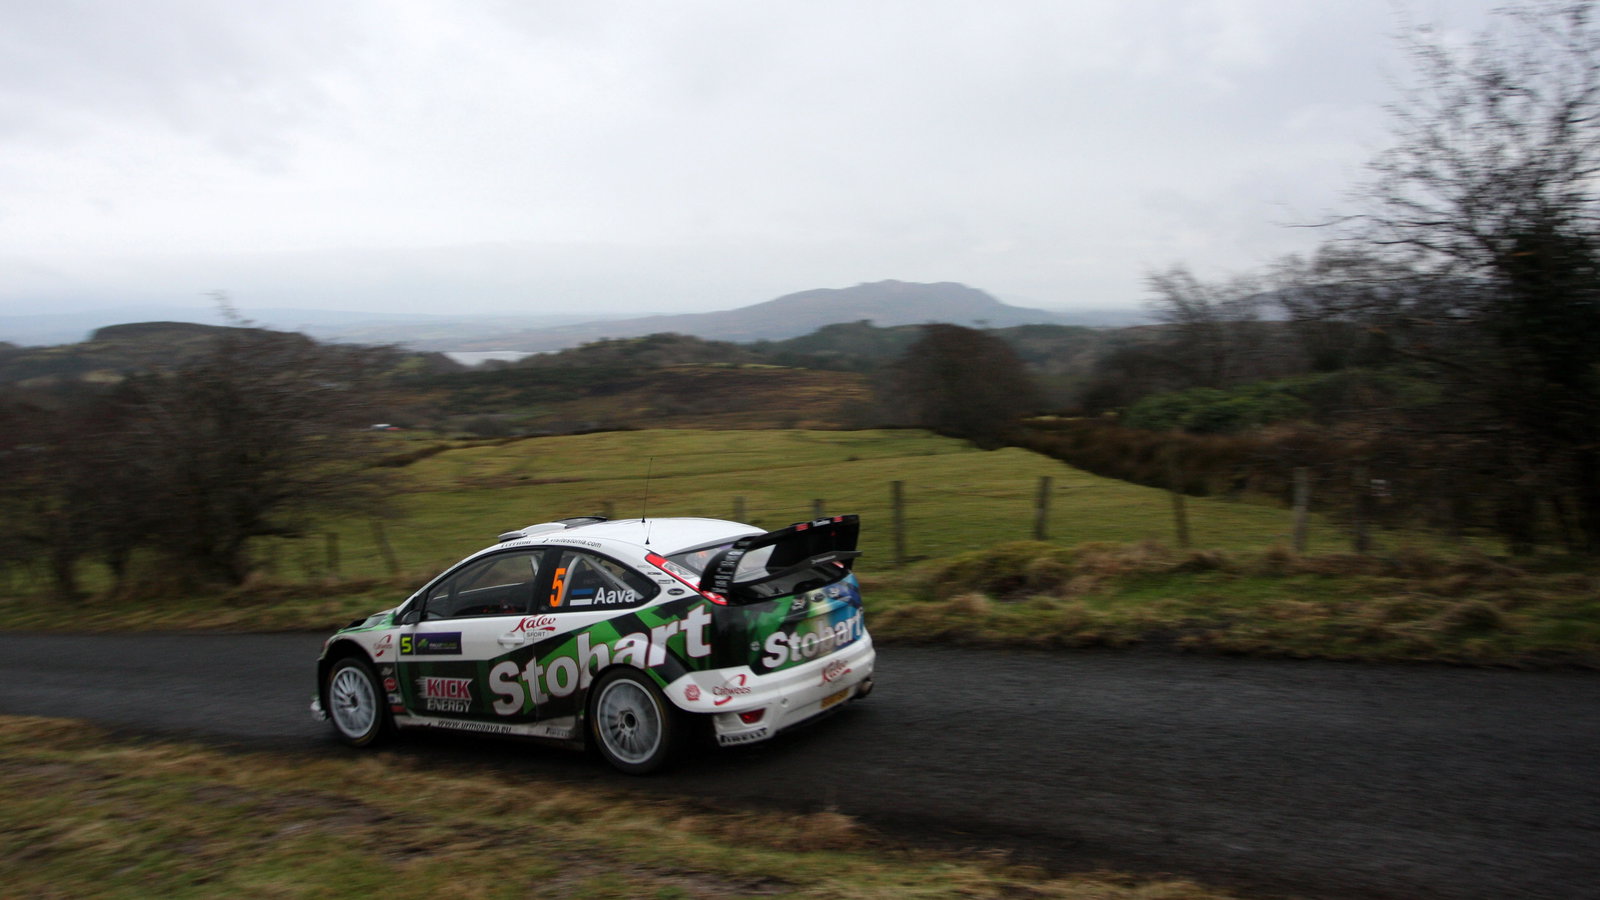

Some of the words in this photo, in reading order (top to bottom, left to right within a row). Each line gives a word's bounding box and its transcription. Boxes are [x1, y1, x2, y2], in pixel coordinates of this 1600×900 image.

[550, 567, 566, 607] 5
[593, 587, 635, 604] Aava
[512, 614, 556, 633] Kalev
[401, 636, 412, 653] 5
[762, 607, 863, 668] Stobart
[489, 603, 712, 716] Stobart
[426, 678, 471, 699] KICK
[427, 699, 471, 712] ENERGY
[438, 719, 511, 734] www.urmoaava.eu
